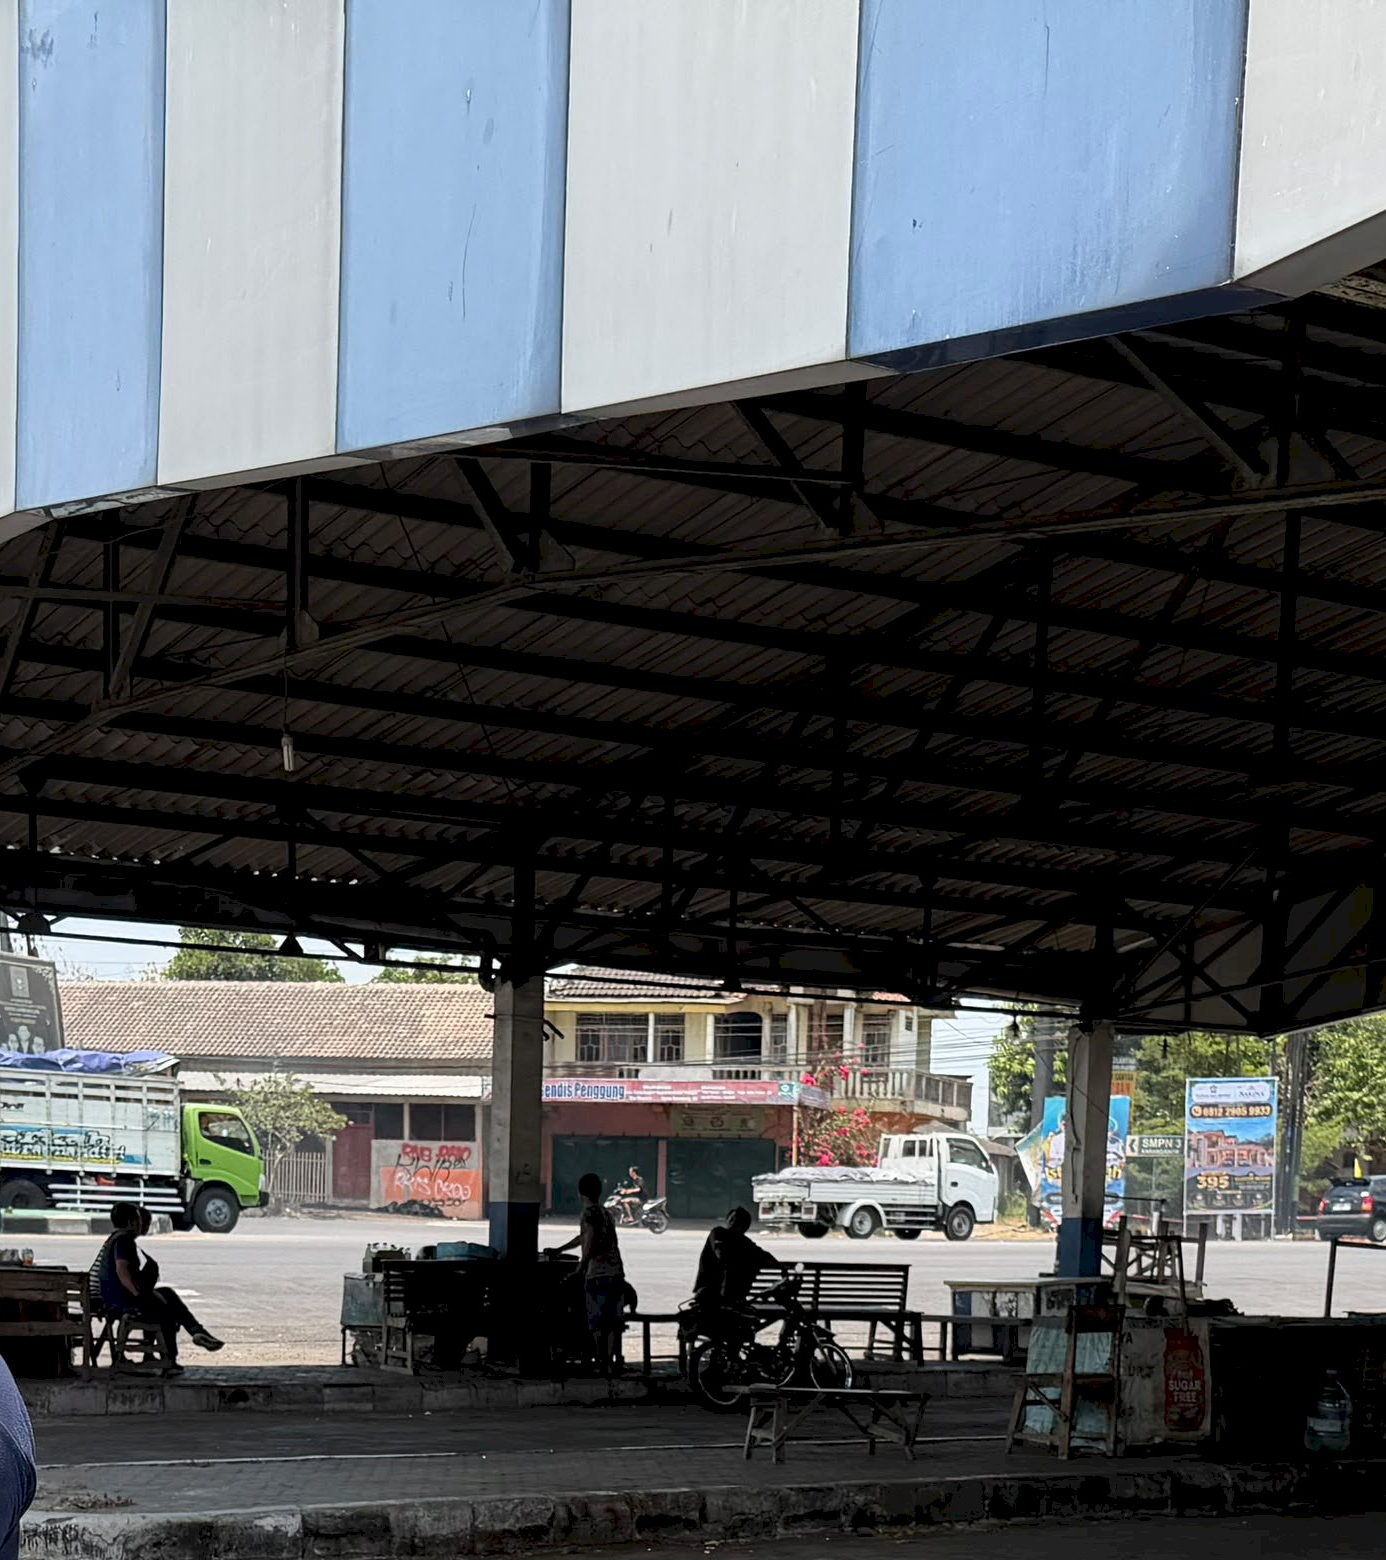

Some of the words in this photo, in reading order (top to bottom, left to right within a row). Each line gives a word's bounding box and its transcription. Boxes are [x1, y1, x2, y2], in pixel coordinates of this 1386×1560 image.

[545, 1083, 573, 1098] endis
[574, 1083, 625, 1100] Penggung
[1142, 1138, 1173, 1148] SMPN
[1175, 1138, 1182, 1149] 3
[1196, 1175, 1230, 1190] 395
[1168, 1379, 1202, 1392] SUGAR
[1173, 1391, 1197, 1403] FREE
